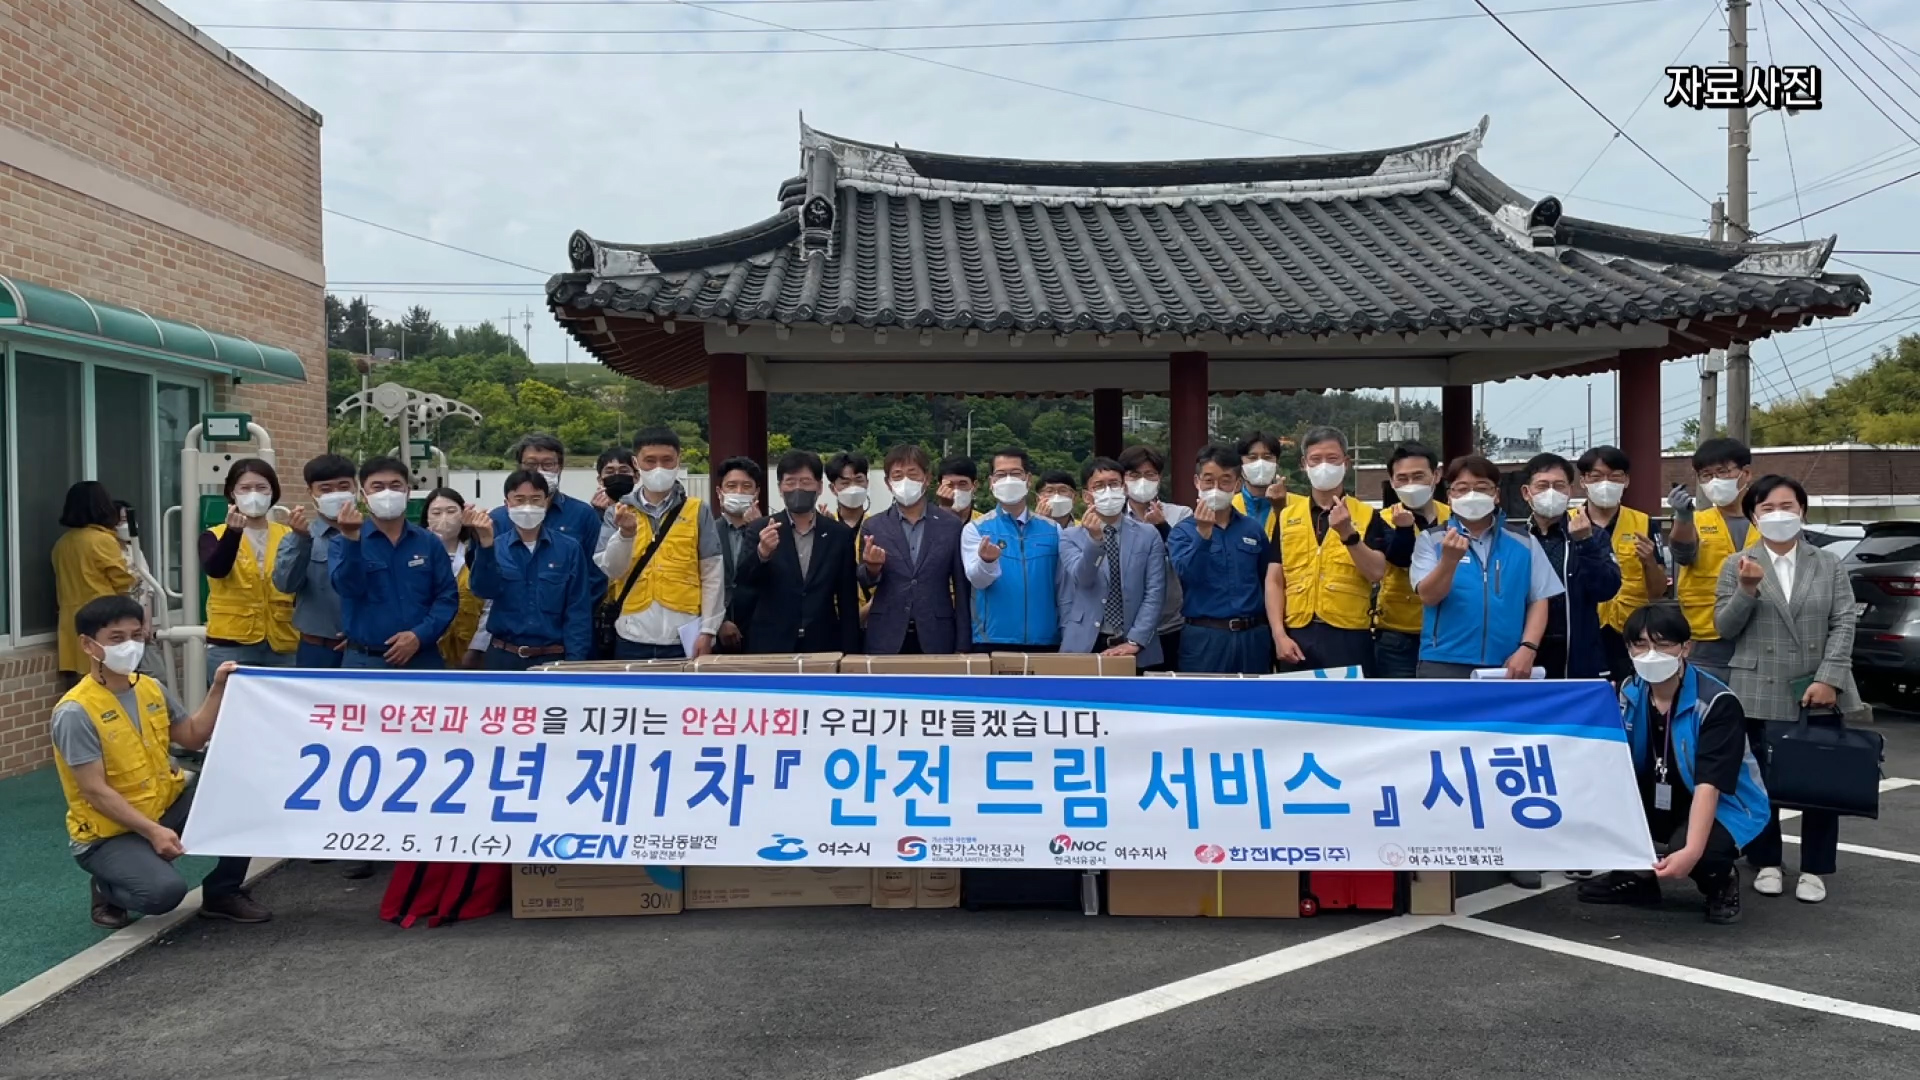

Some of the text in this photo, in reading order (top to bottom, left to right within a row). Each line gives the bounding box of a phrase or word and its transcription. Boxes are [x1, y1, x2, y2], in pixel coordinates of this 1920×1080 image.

[309, 703, 1109, 738] 국민 안전과 생명을 지키는 안심사회! 우리가 만들겠습니다.
[284, 742, 547, 823] 2022년
[824, 743, 952, 827] 안전
[977, 745, 1108, 828] 드림
[1138, 746, 1351, 829] 서비스
[1422, 744, 1563, 830] 시행
[633, 834, 718, 851] 한국남동발전
[818, 841, 872, 858] 여수시
[931, 843, 1026, 857] 한국가스안전공사
[1114, 846, 1168, 861] 여수지사
[1408, 854, 1505, 866] 여수시노인복지관
